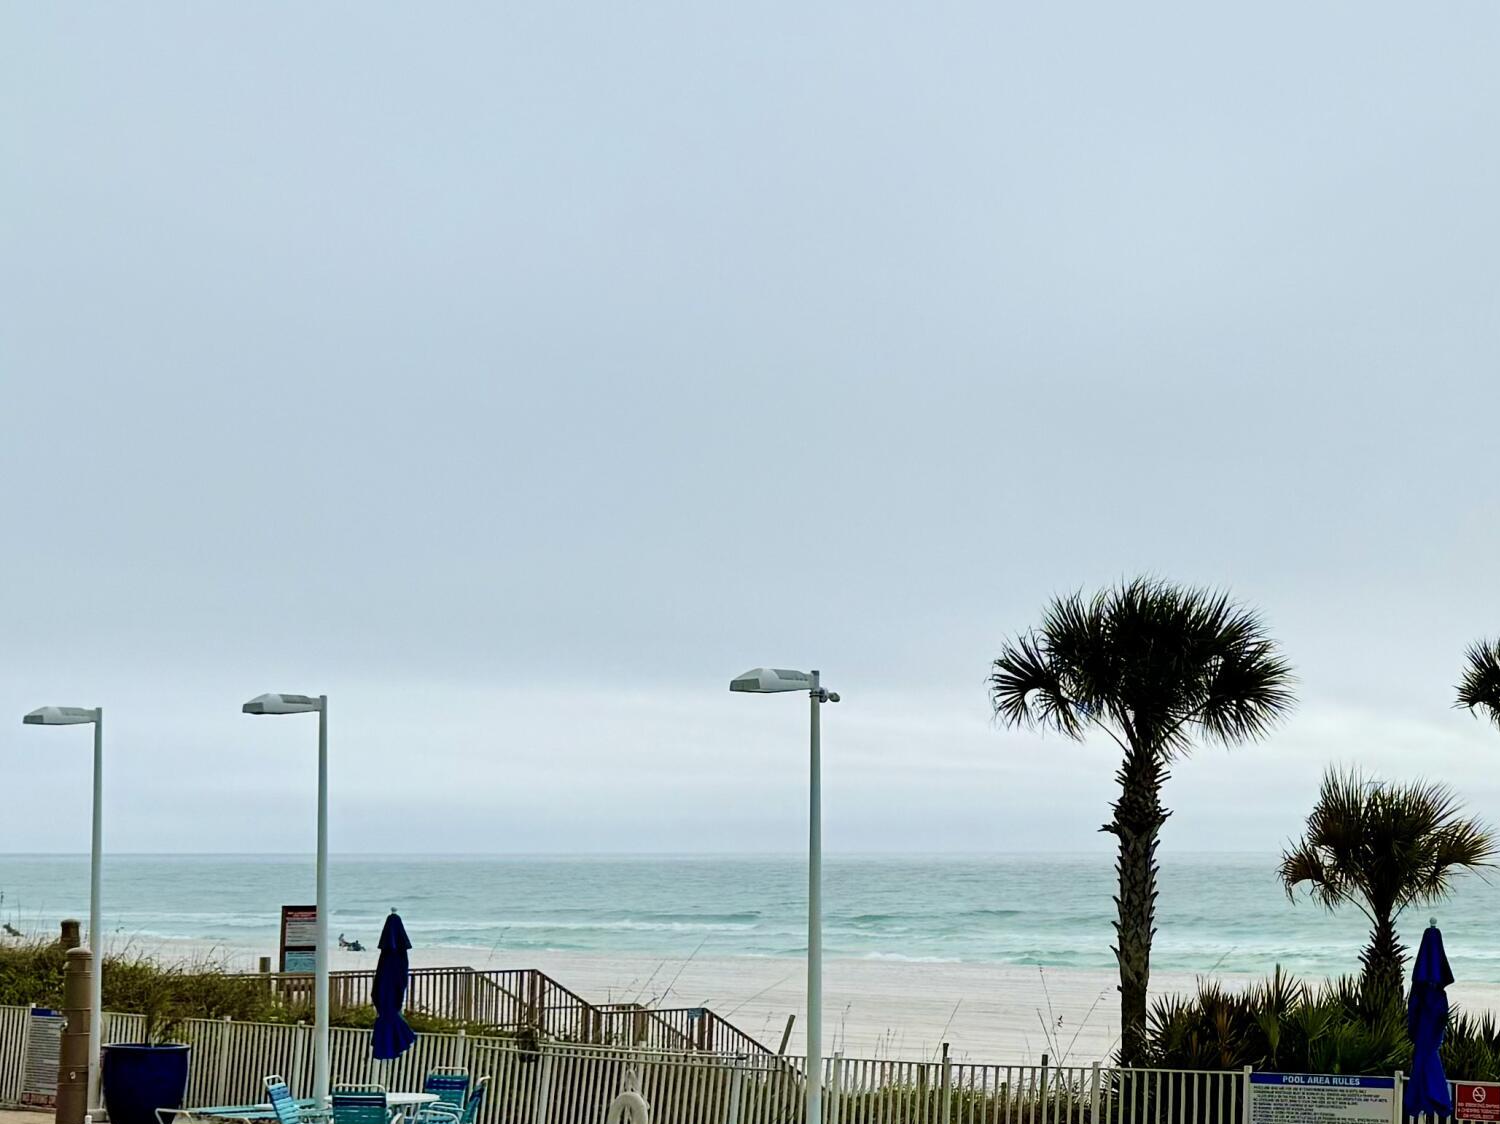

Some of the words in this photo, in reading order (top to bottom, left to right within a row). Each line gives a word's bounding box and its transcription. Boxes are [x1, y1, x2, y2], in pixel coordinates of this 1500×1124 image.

[1282, 1075, 1305, 1084] POOL
[1307, 1076, 1330, 1085] AREA
[1332, 1077, 1360, 1086] RULES
